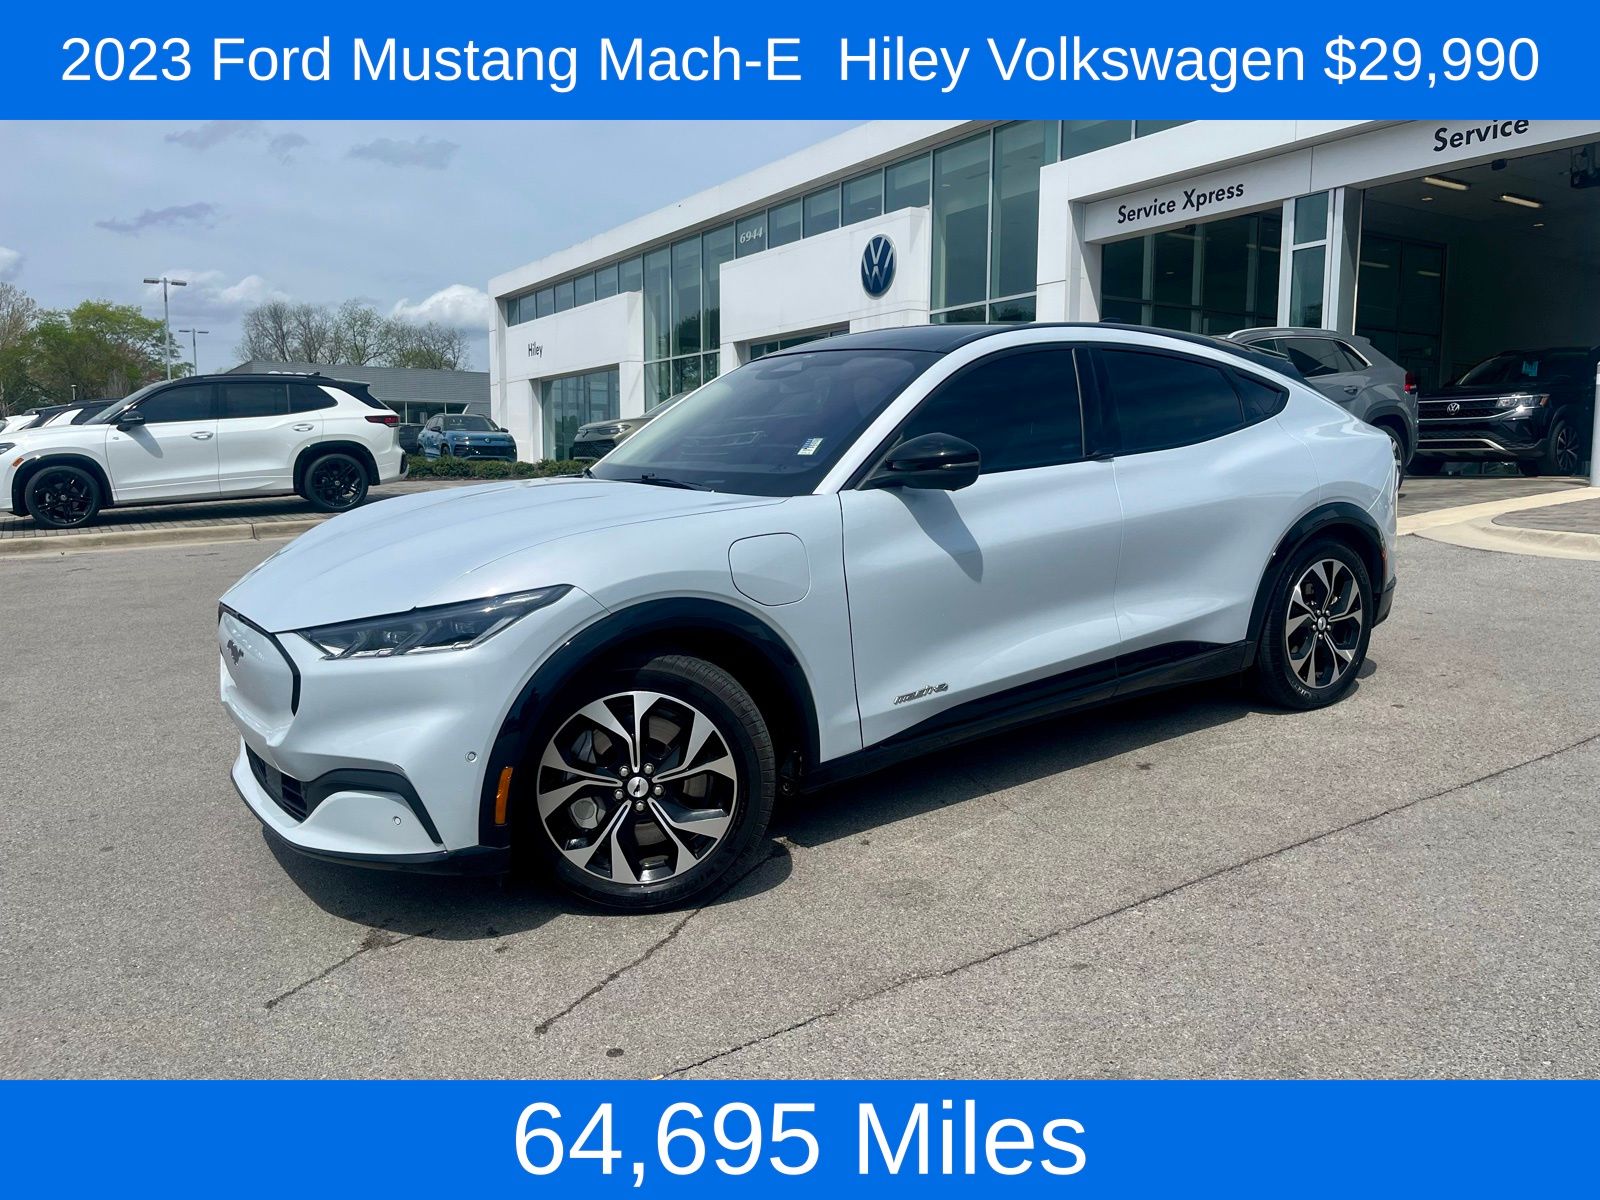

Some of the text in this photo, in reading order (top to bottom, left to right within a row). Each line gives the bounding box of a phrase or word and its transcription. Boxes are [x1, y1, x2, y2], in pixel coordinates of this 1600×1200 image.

[1433, 120, 1529, 152] Service
[1117, 183, 1244, 224] Service Xpress
[740, 226, 763, 244] 6944
[861, 233, 897, 300] VW
[527, 341, 544, 358] Hiley
